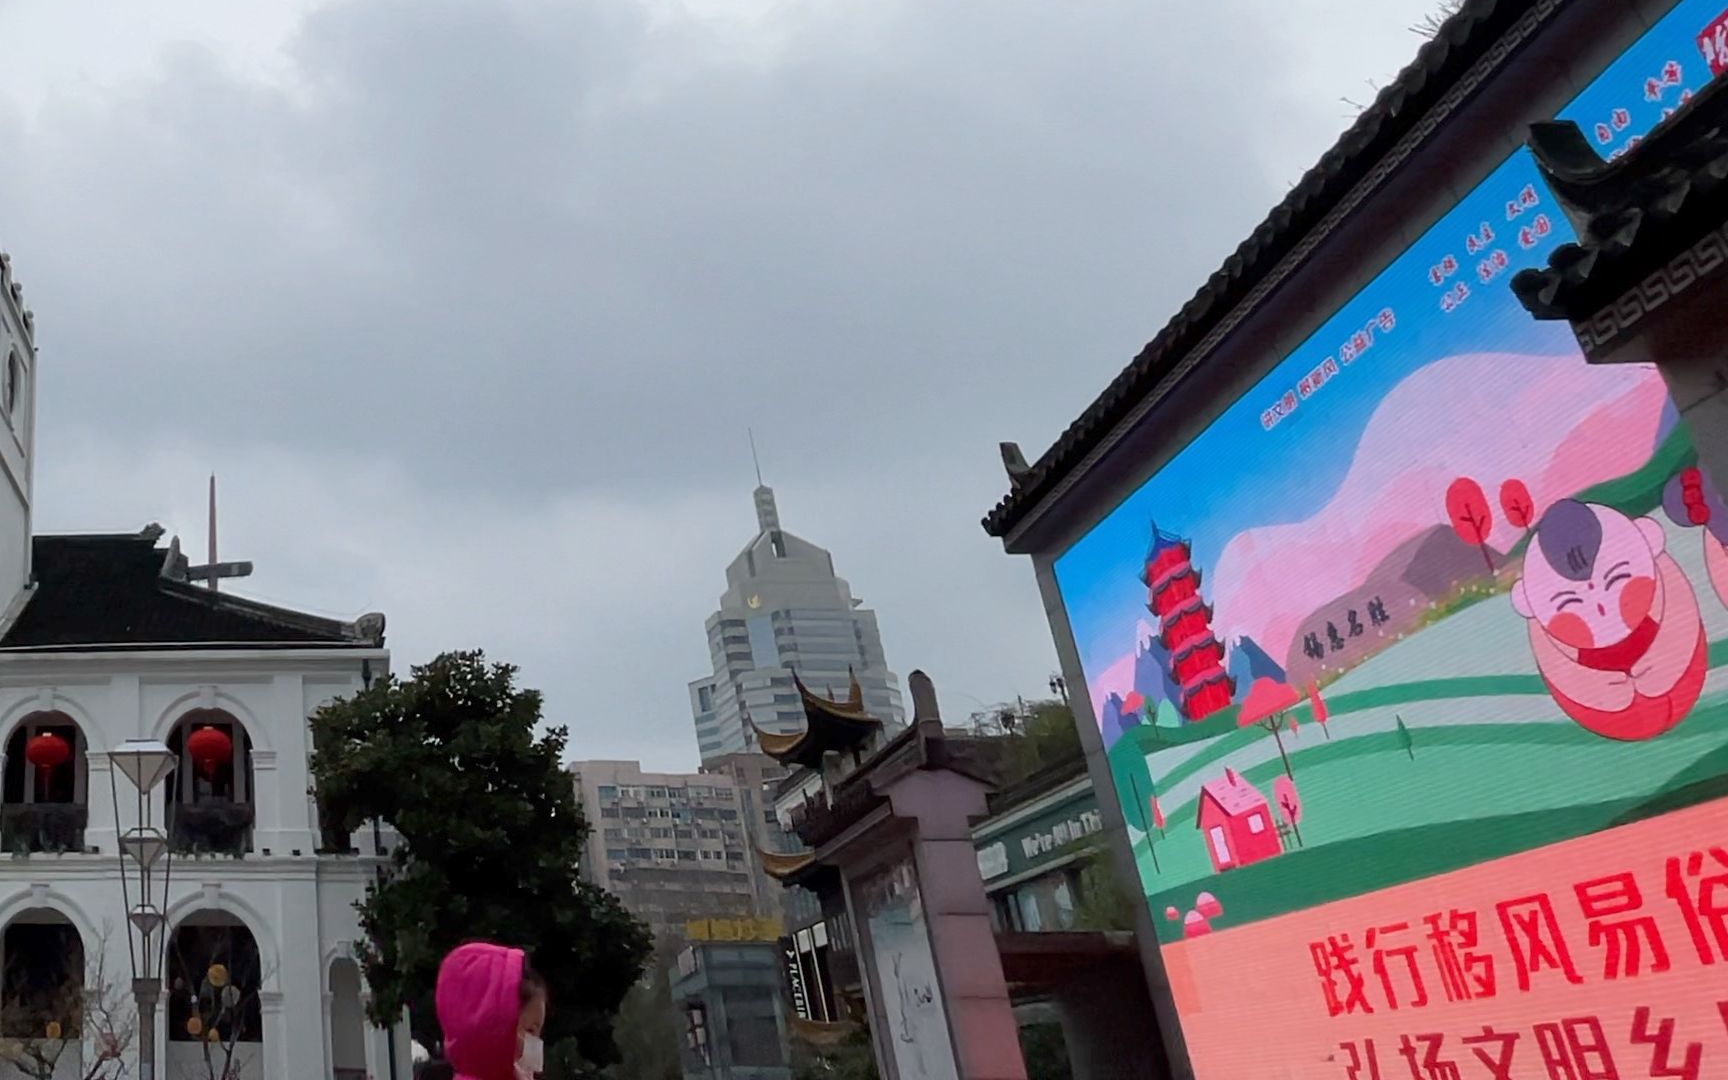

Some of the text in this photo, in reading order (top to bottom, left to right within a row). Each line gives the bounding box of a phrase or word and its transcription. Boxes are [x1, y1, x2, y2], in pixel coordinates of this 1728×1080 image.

[1340, 308, 1396, 365] 公益广告
[1309, 846, 1728, 1017] 践行移风易俗
[1339, 1001, 1728, 1080] 弘扬文明乡
